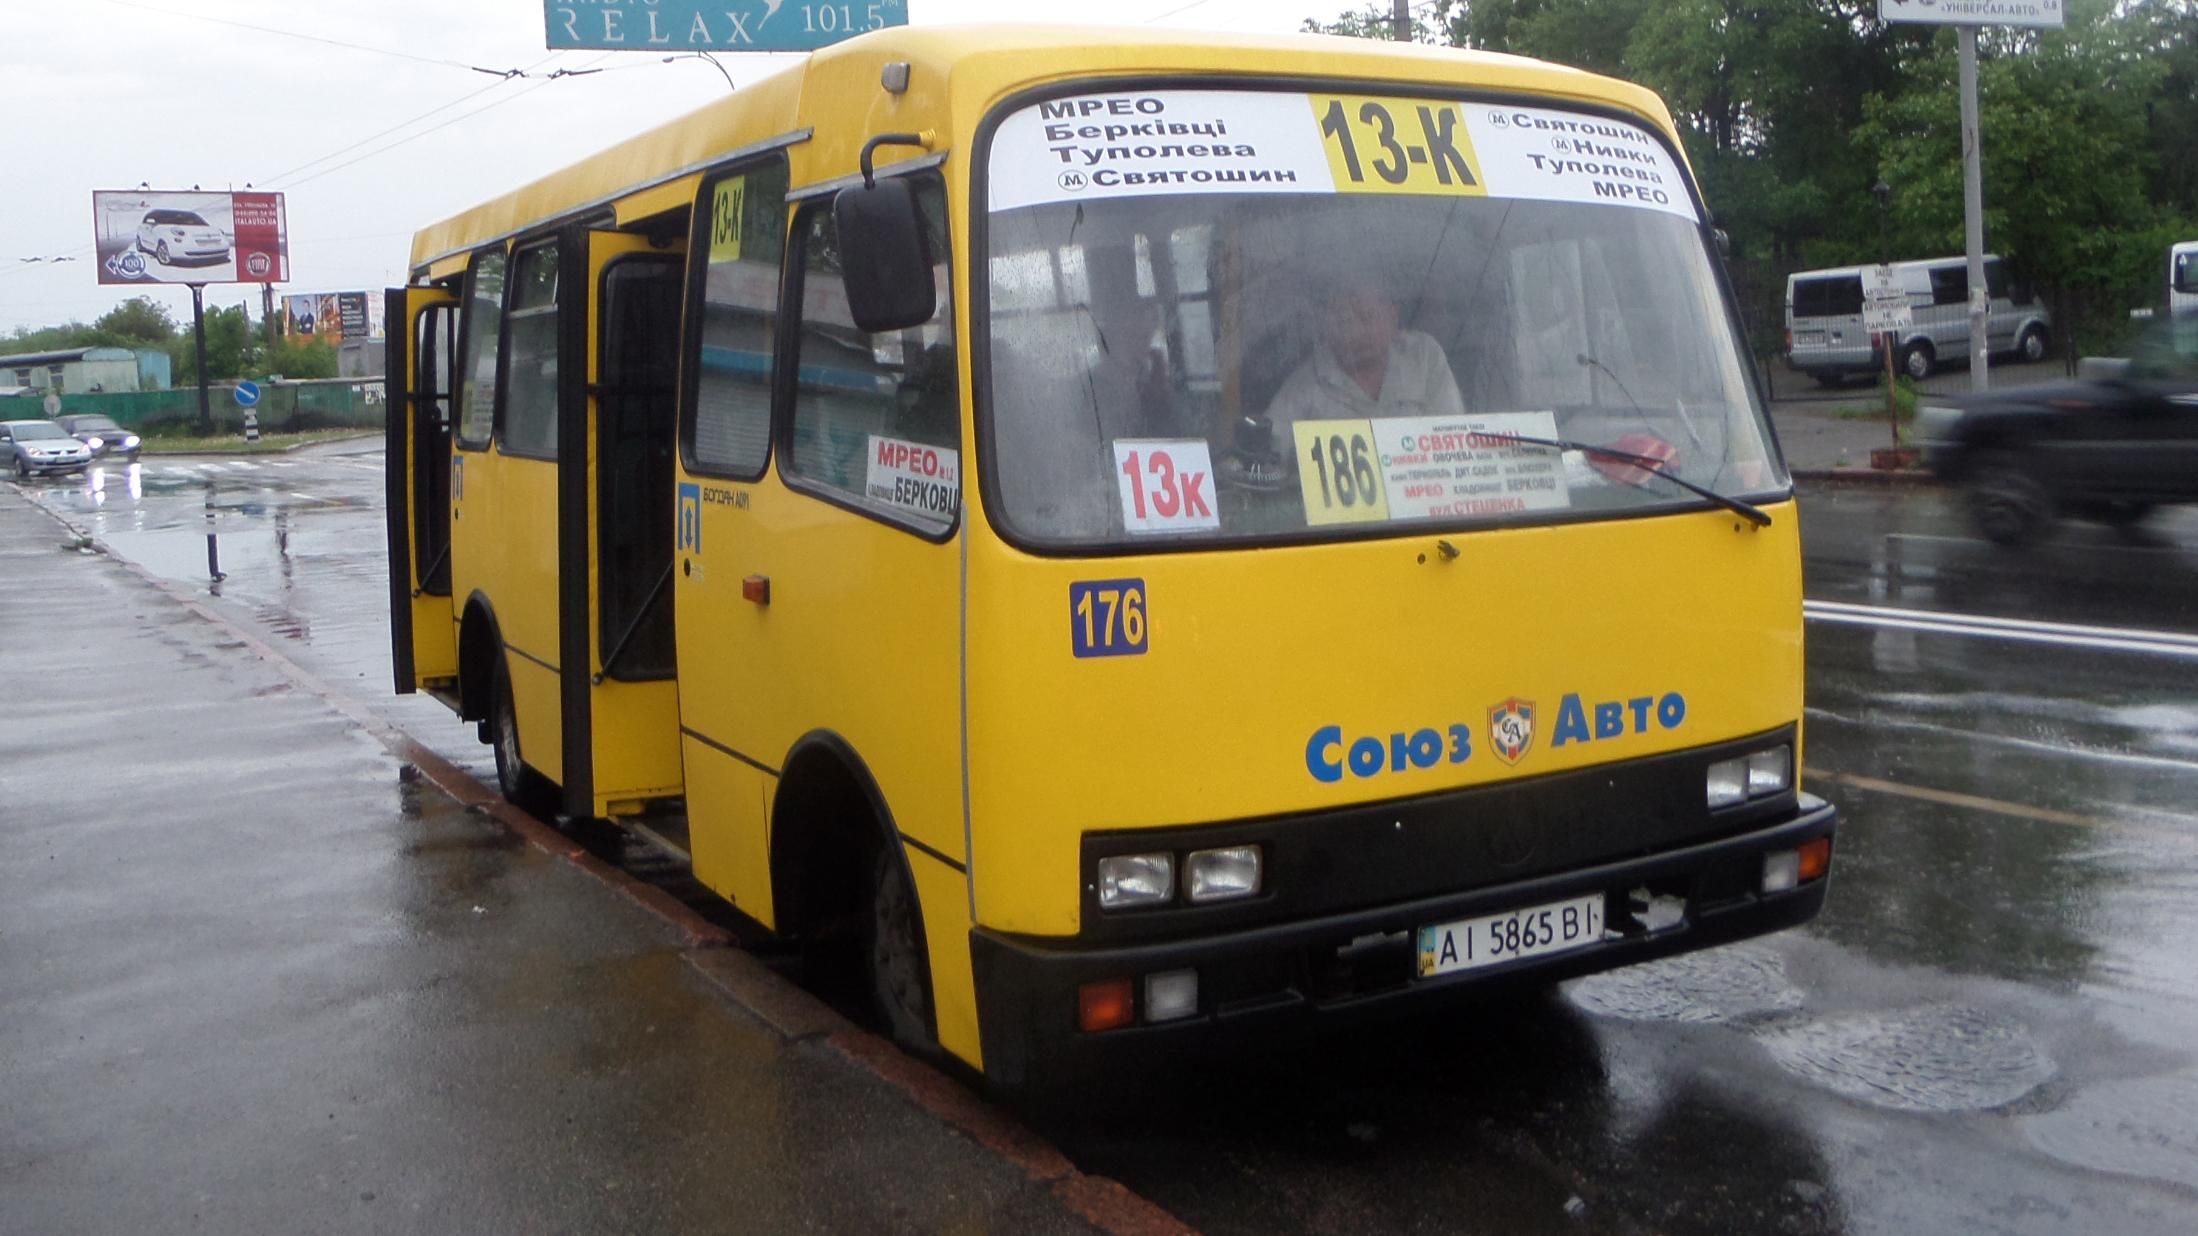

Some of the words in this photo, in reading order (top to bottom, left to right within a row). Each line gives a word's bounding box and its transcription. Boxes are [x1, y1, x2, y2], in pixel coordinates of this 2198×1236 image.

[557, 8, 754, 44] RELAX
[801, 4, 885, 33] 101.5
[1038, 98, 1165, 120] МРЕО
[1044, 119, 1227, 141] Берківці
[1321, 100, 1477, 186] 13-К
[1511, 113, 1650, 145] Святошин
[1050, 144, 1257, 166] Туполева
[1575, 138, 1657, 165] Нивки
[1092, 169, 1297, 186] Святошин
[1527, 153, 1663, 184] Туполева
[1593, 180, 1669, 204] МРЕО
[878, 440, 938, 477] МРЕО
[1311, 433, 1377, 508] 186
[1405, 483, 1443, 498] МРЕО
[1078, 588, 1144, 648] 176
[1305, 723, 1472, 783] Союз
[1550, 692, 1686, 748] Авто
[1490, 910, 1553, 954] 5865
